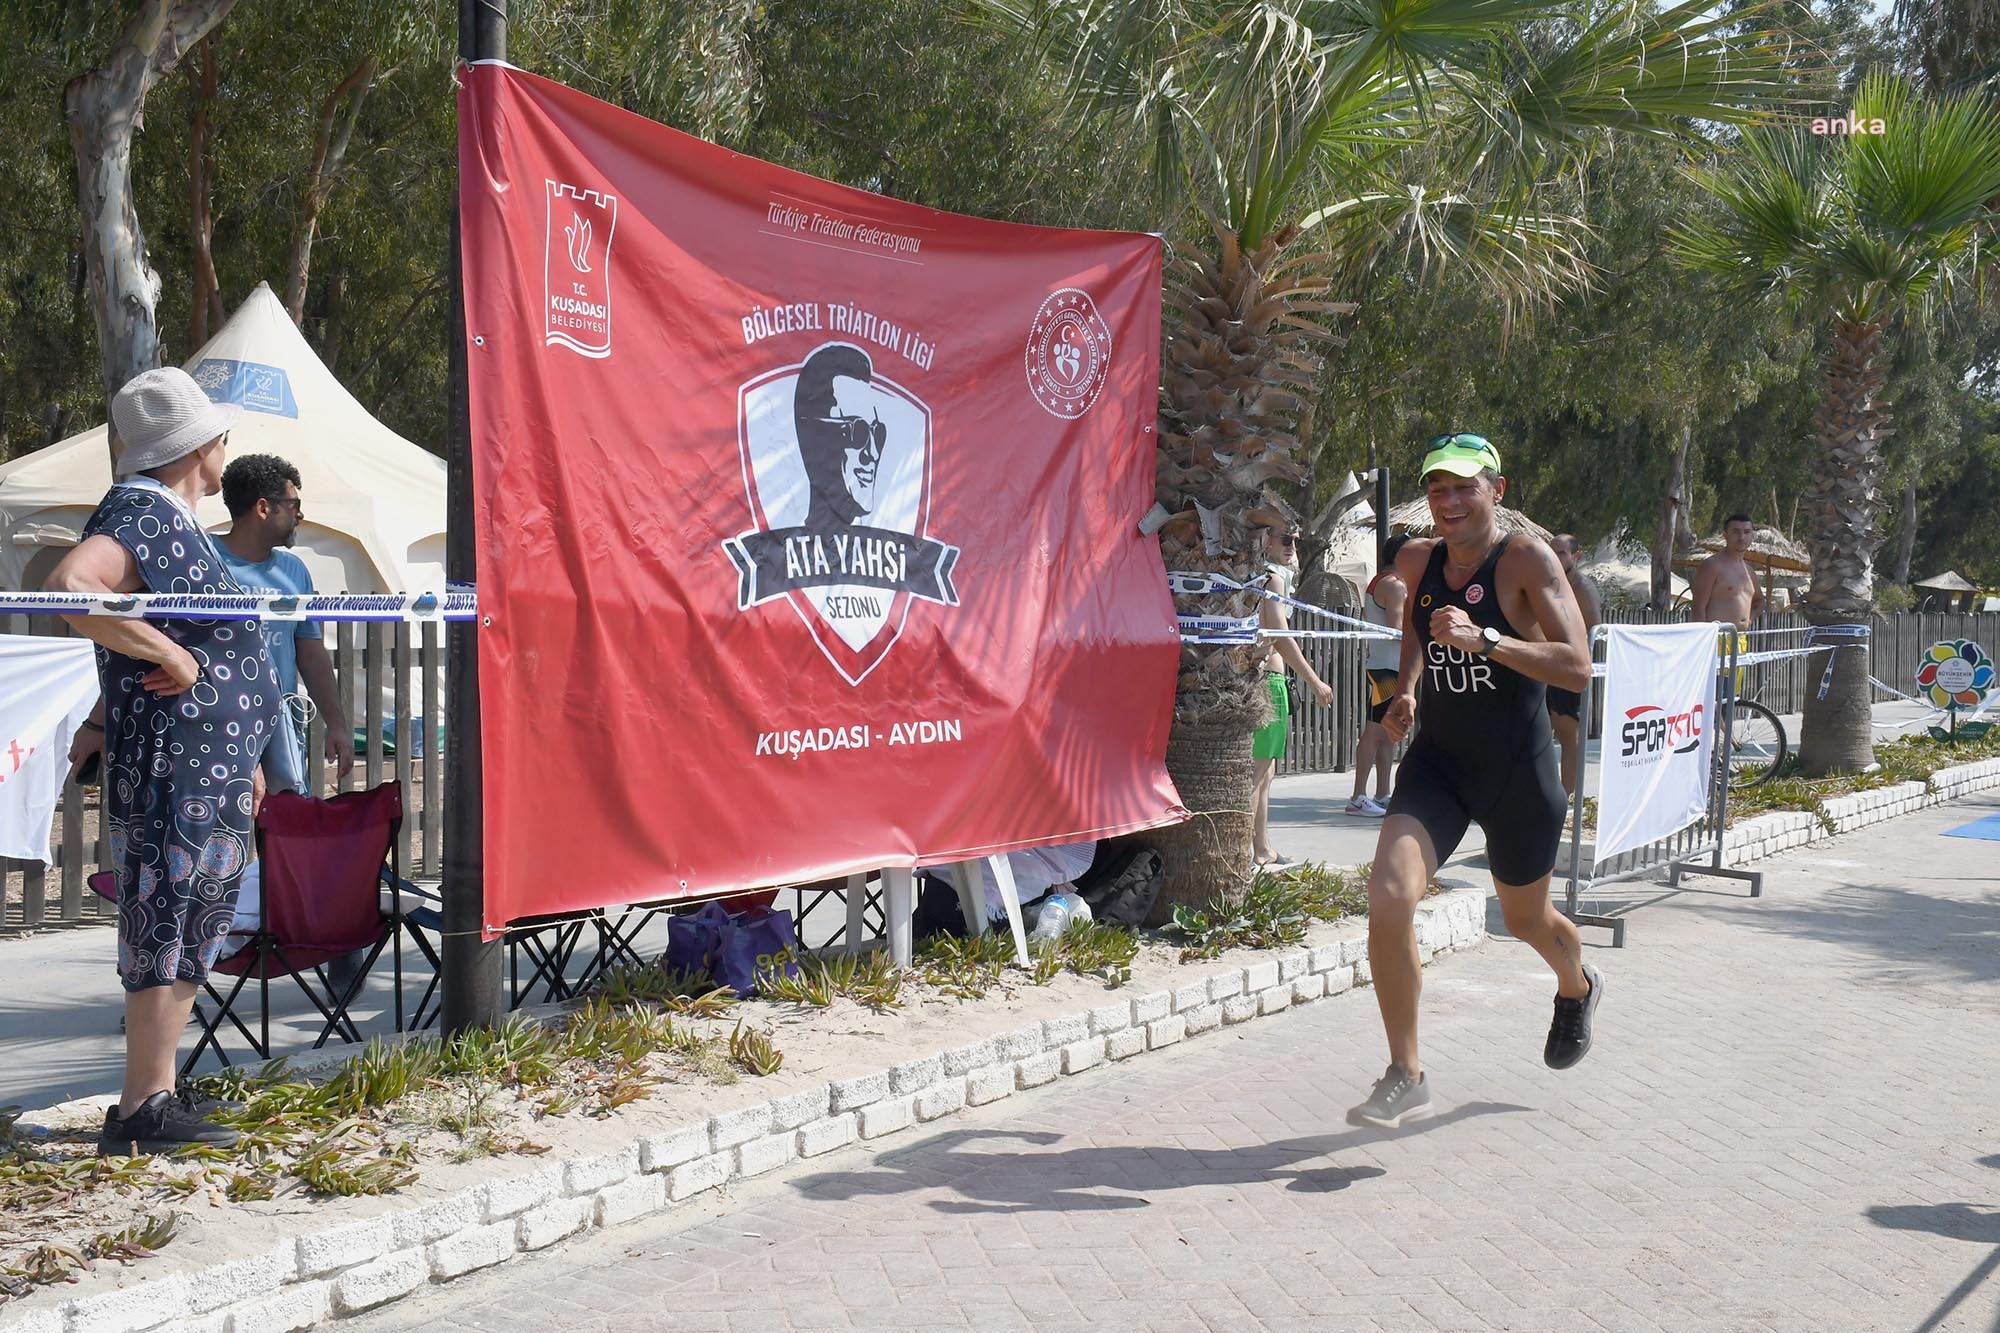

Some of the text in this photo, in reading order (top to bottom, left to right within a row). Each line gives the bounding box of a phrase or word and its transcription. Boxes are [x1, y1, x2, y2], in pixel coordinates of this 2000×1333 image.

[767, 202, 921, 253] Türkiye Triatlon Federasyonu
[572, 282, 588, 297] T.C.
[551, 296, 606, 320] KUŞADASI
[551, 314, 606, 334] BELEDİYESİ
[741, 302, 936, 371] BÖLGESEL TRİATLON LİGİ
[785, 534, 906, 583] ATA YAHŞİ
[826, 596, 881, 620] SEZONU
[1428, 665, 1496, 693] TUR
[755, 725, 870, 760] KUŞADASI
[888, 719, 962, 746] AYDIN
